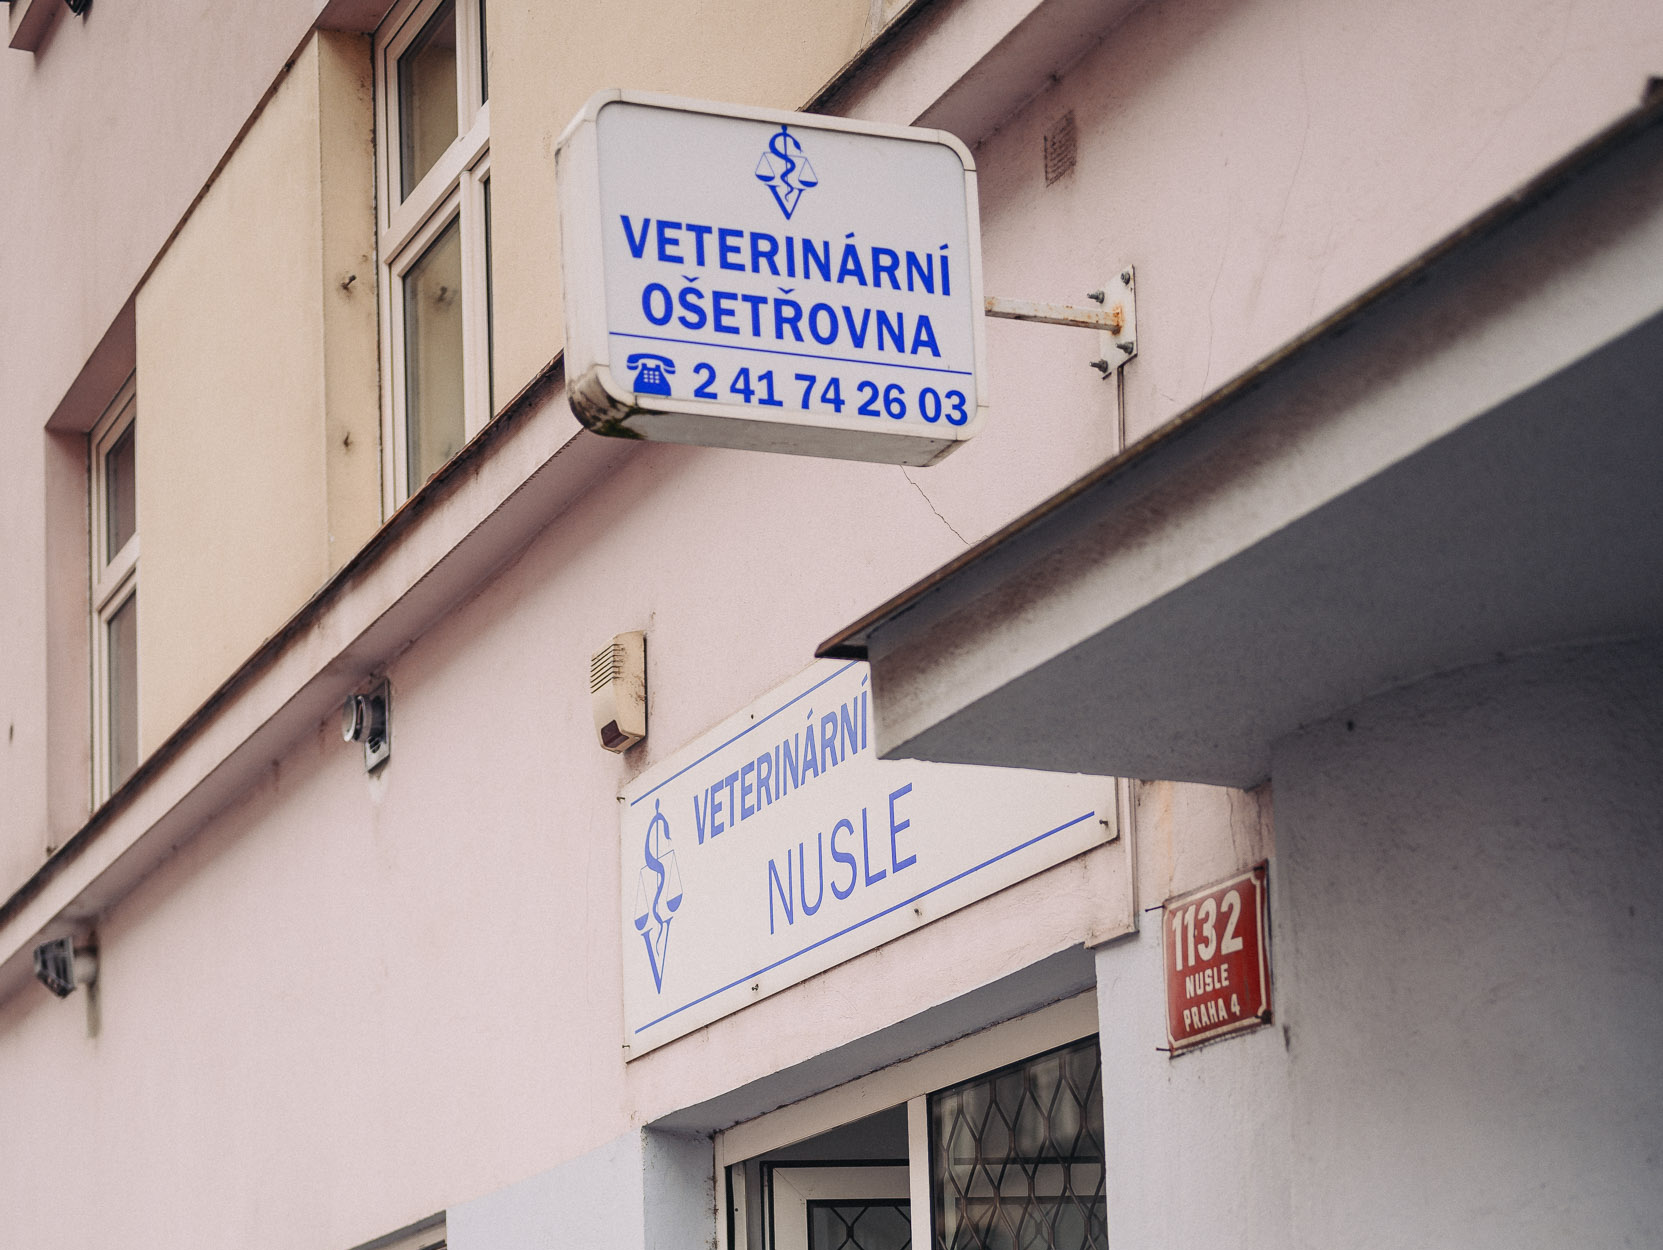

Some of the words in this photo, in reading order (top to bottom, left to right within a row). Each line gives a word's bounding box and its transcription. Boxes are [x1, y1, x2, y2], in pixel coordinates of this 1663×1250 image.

[619, 214, 951, 297] VETERINÁRNÍ
[641, 274, 942, 358] OŠETŘOVNA
[692, 361, 719, 401] 2
[729, 366, 784, 408] 41
[793, 372, 846, 414] 74
[856, 379, 907, 421] 26
[917, 386, 969, 427] 03
[693, 673, 868, 845] VETERINÁRNÍ
[767, 782, 918, 935] NUSLE
[1172, 889, 1244, 972] 1132
[1183, 998, 1229, 1032] PRAHA
[1230, 993, 1241, 1017] 4
[1185, 963, 1230, 999] NUSLE
